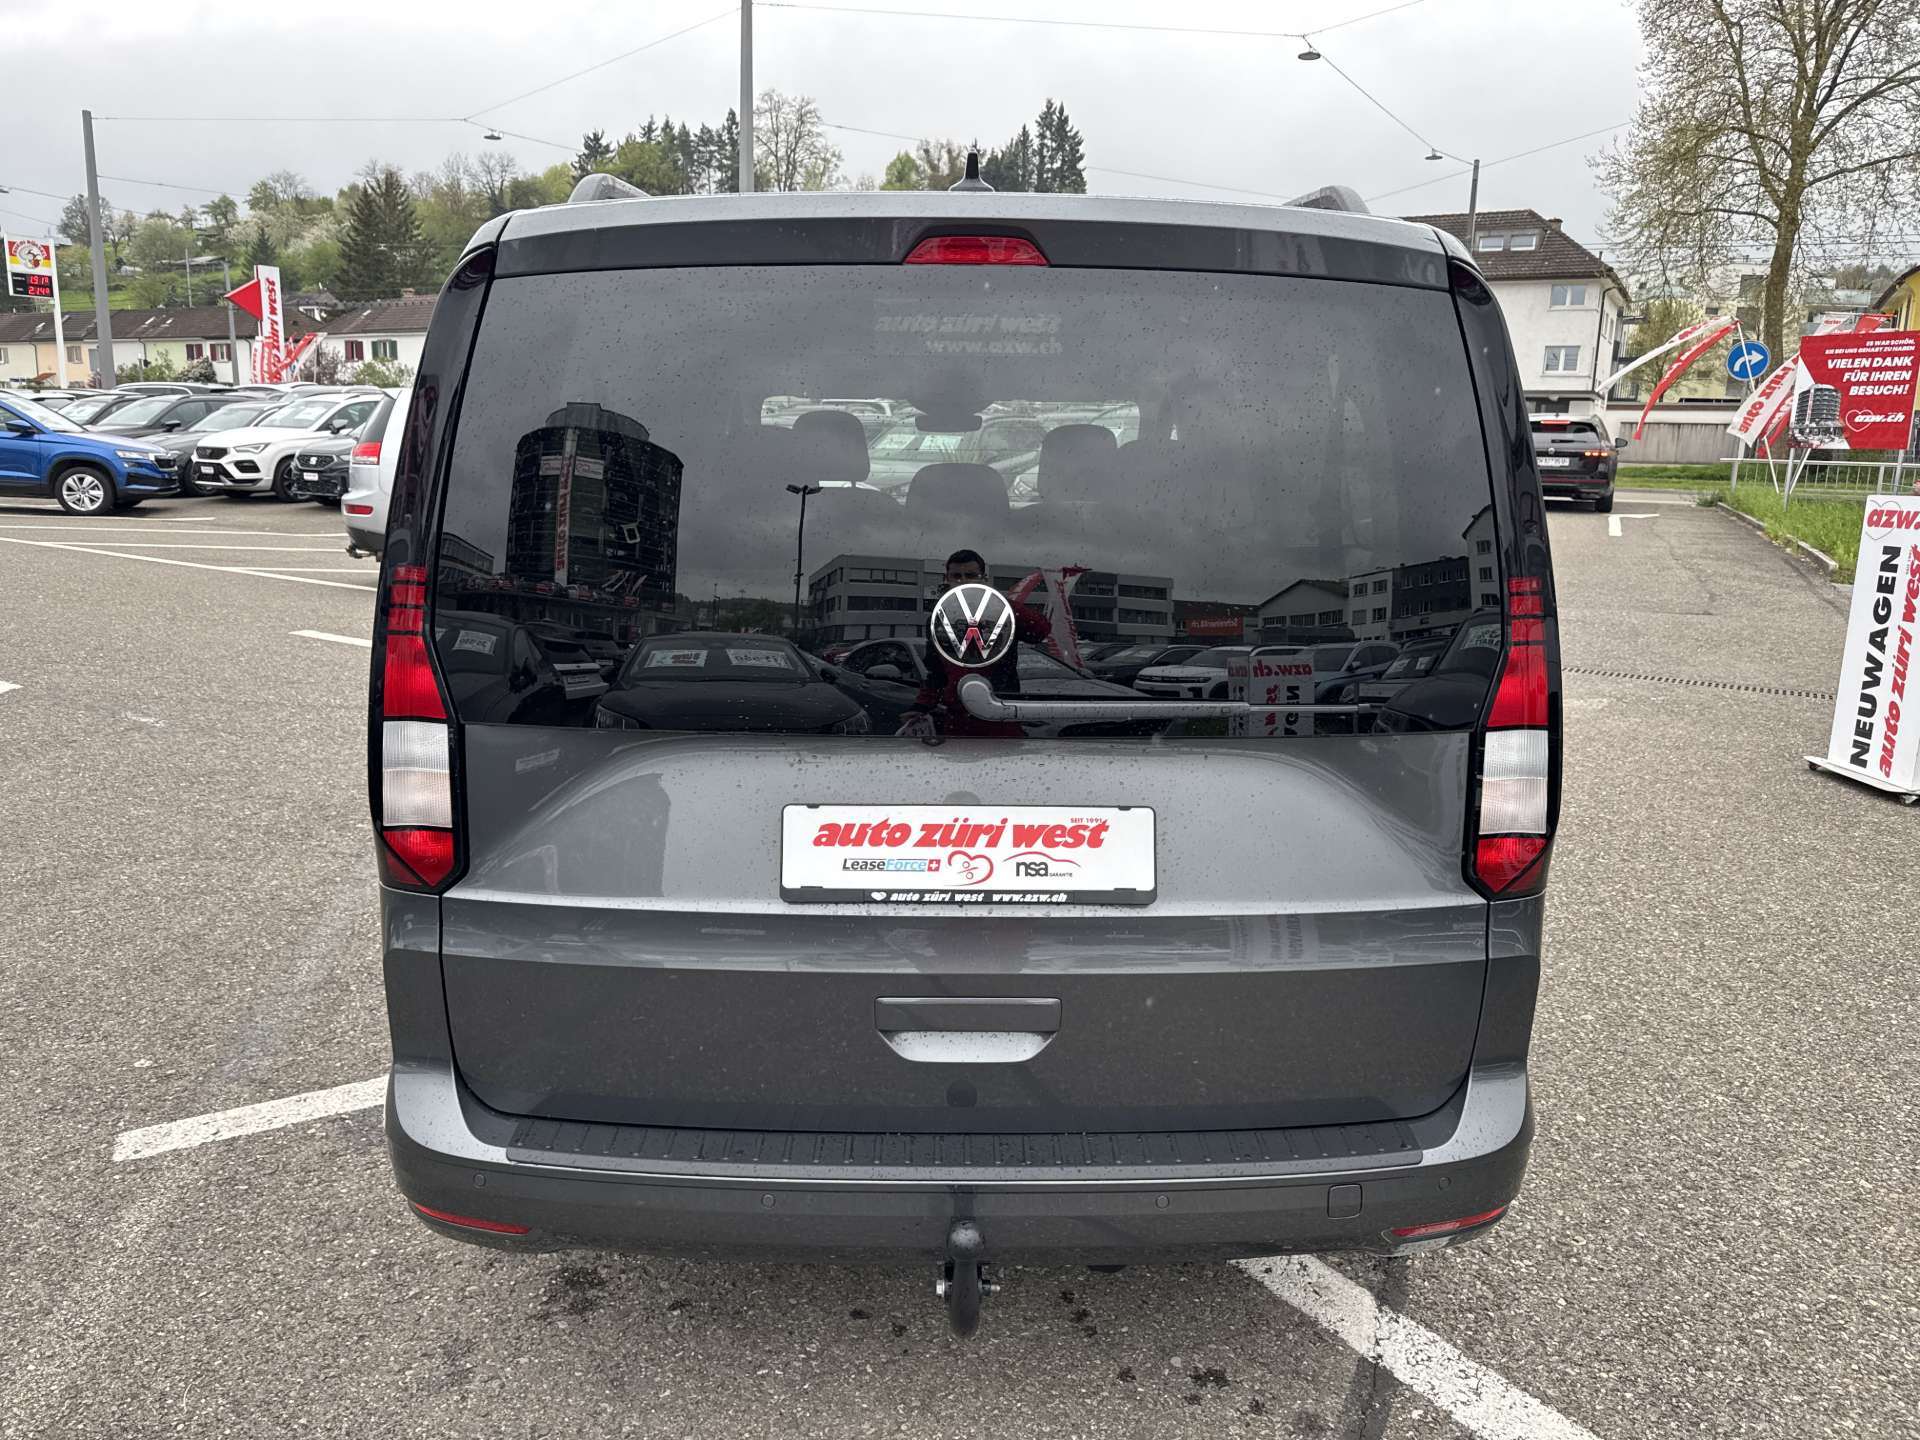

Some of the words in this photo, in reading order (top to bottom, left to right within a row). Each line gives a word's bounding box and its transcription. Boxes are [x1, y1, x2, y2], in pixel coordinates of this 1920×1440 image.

[1827, 358, 1872, 369] VIELEN
[1872, 356, 1914, 367] DANK
[1843, 370, 1871, 382] FÜR
[1871, 370, 1912, 381] IHREN
[1849, 384, 1910, 396] BESUCH!
[1854, 412, 1905, 423] azw.ch
[1850, 545, 1902, 769] NEUWAGEN
[1879, 699, 1901, 779] auto
[1891, 625, 1913, 701] züri
[813, 817, 912, 847] auto
[913, 817, 1008, 848] züri
[1012, 819, 1109, 848] west
[842, 858, 927, 871] LeaseForce
[1016, 861, 1049, 877] nsa
[889, 892, 920, 901] auto
[923, 891, 951, 901] züri
[954, 892, 985, 901] west
[992, 893, 1068, 902] www.azw.ch
